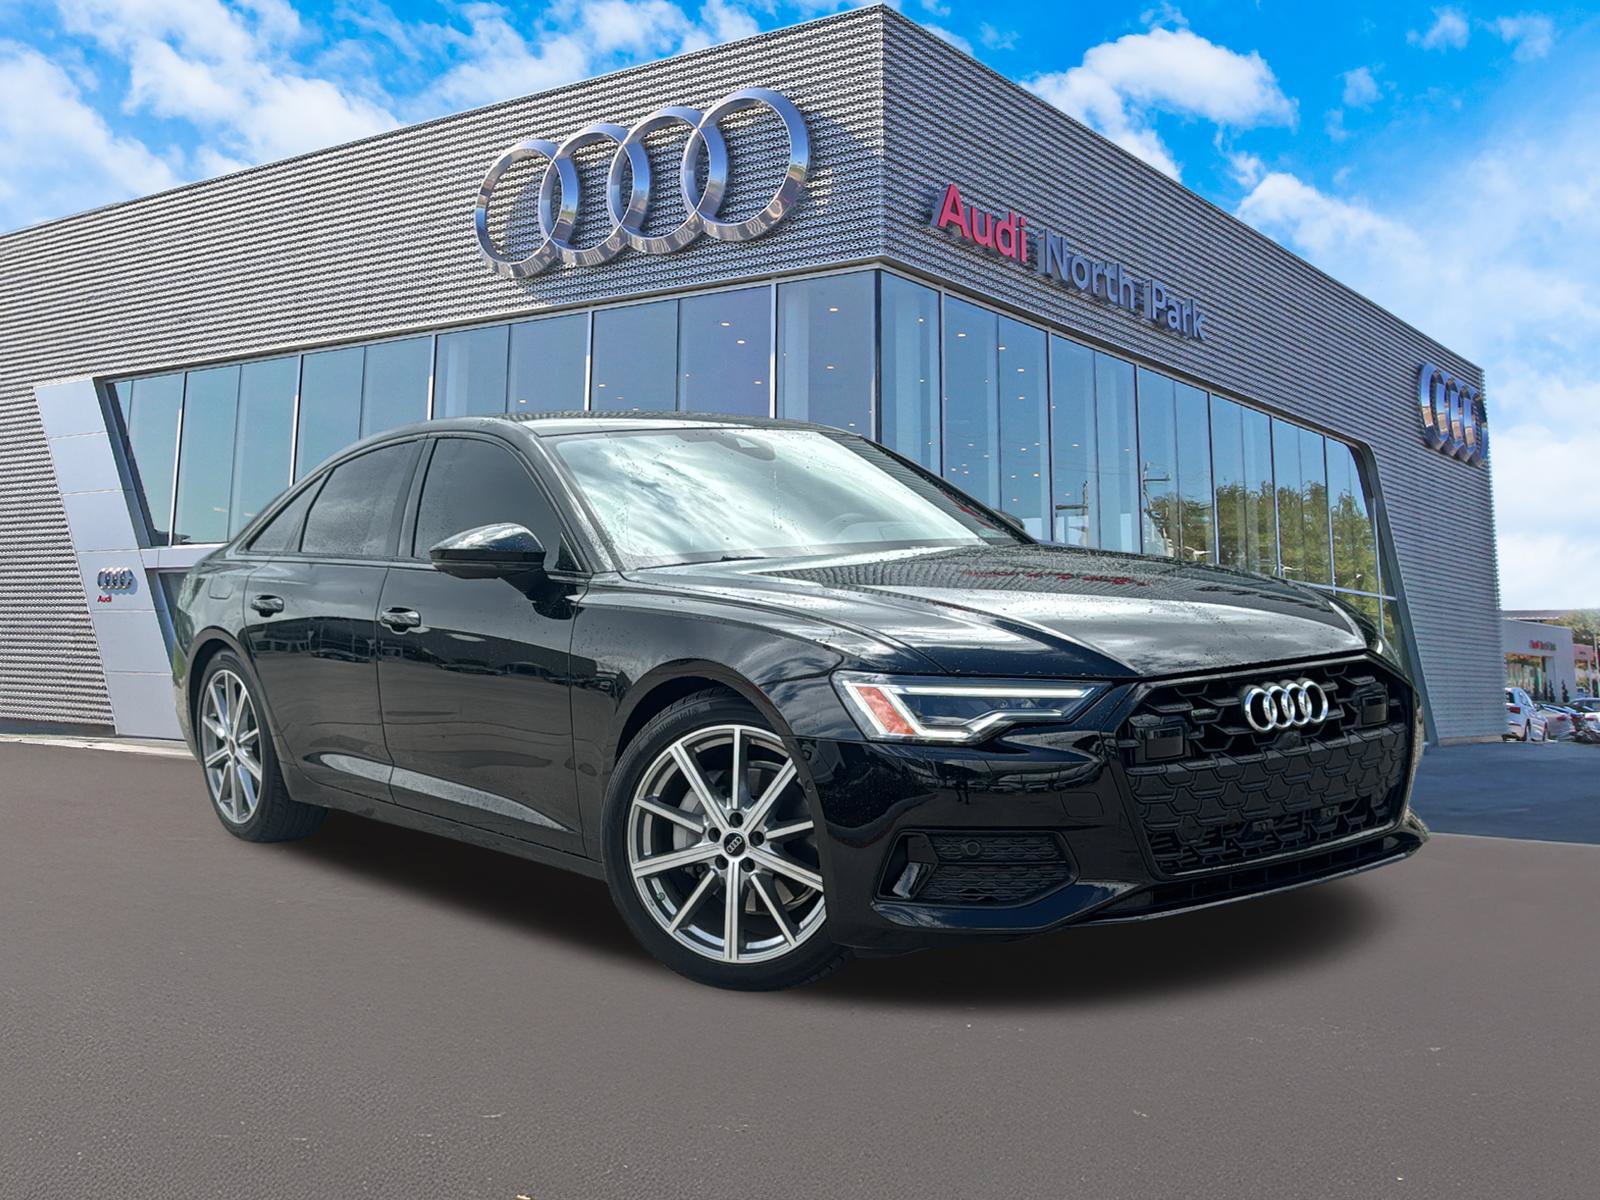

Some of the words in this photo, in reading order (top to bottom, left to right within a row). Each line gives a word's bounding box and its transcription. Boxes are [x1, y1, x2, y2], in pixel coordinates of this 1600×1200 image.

[931, 183, 1027, 263] Audi
[1039, 229, 1136, 312] North
[1145, 279, 1206, 341] Park
